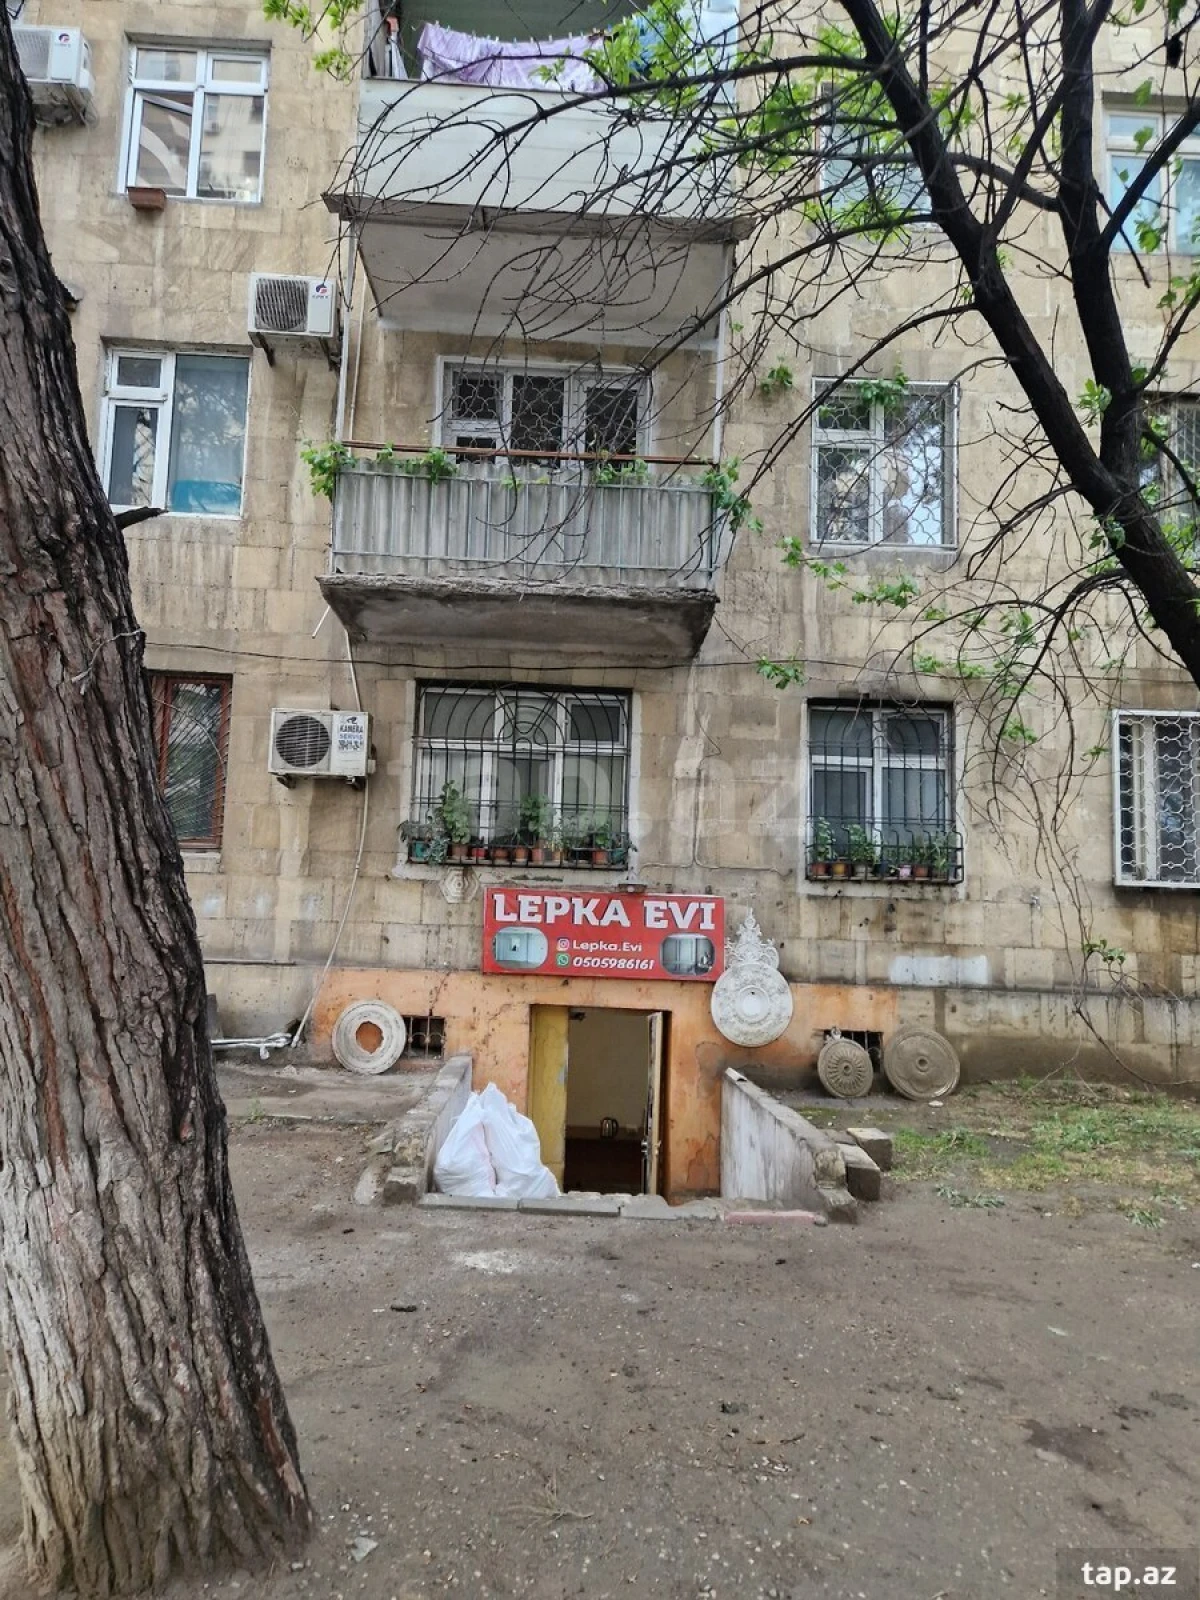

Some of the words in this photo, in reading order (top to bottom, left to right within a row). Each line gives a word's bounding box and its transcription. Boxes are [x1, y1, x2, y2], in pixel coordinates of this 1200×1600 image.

[493, 893, 631, 928] LEPKA
[643, 900, 716, 930] EVI
[572, 939, 643, 953] Lepka.Evi
[573, 956, 655, 970] 0505986161
